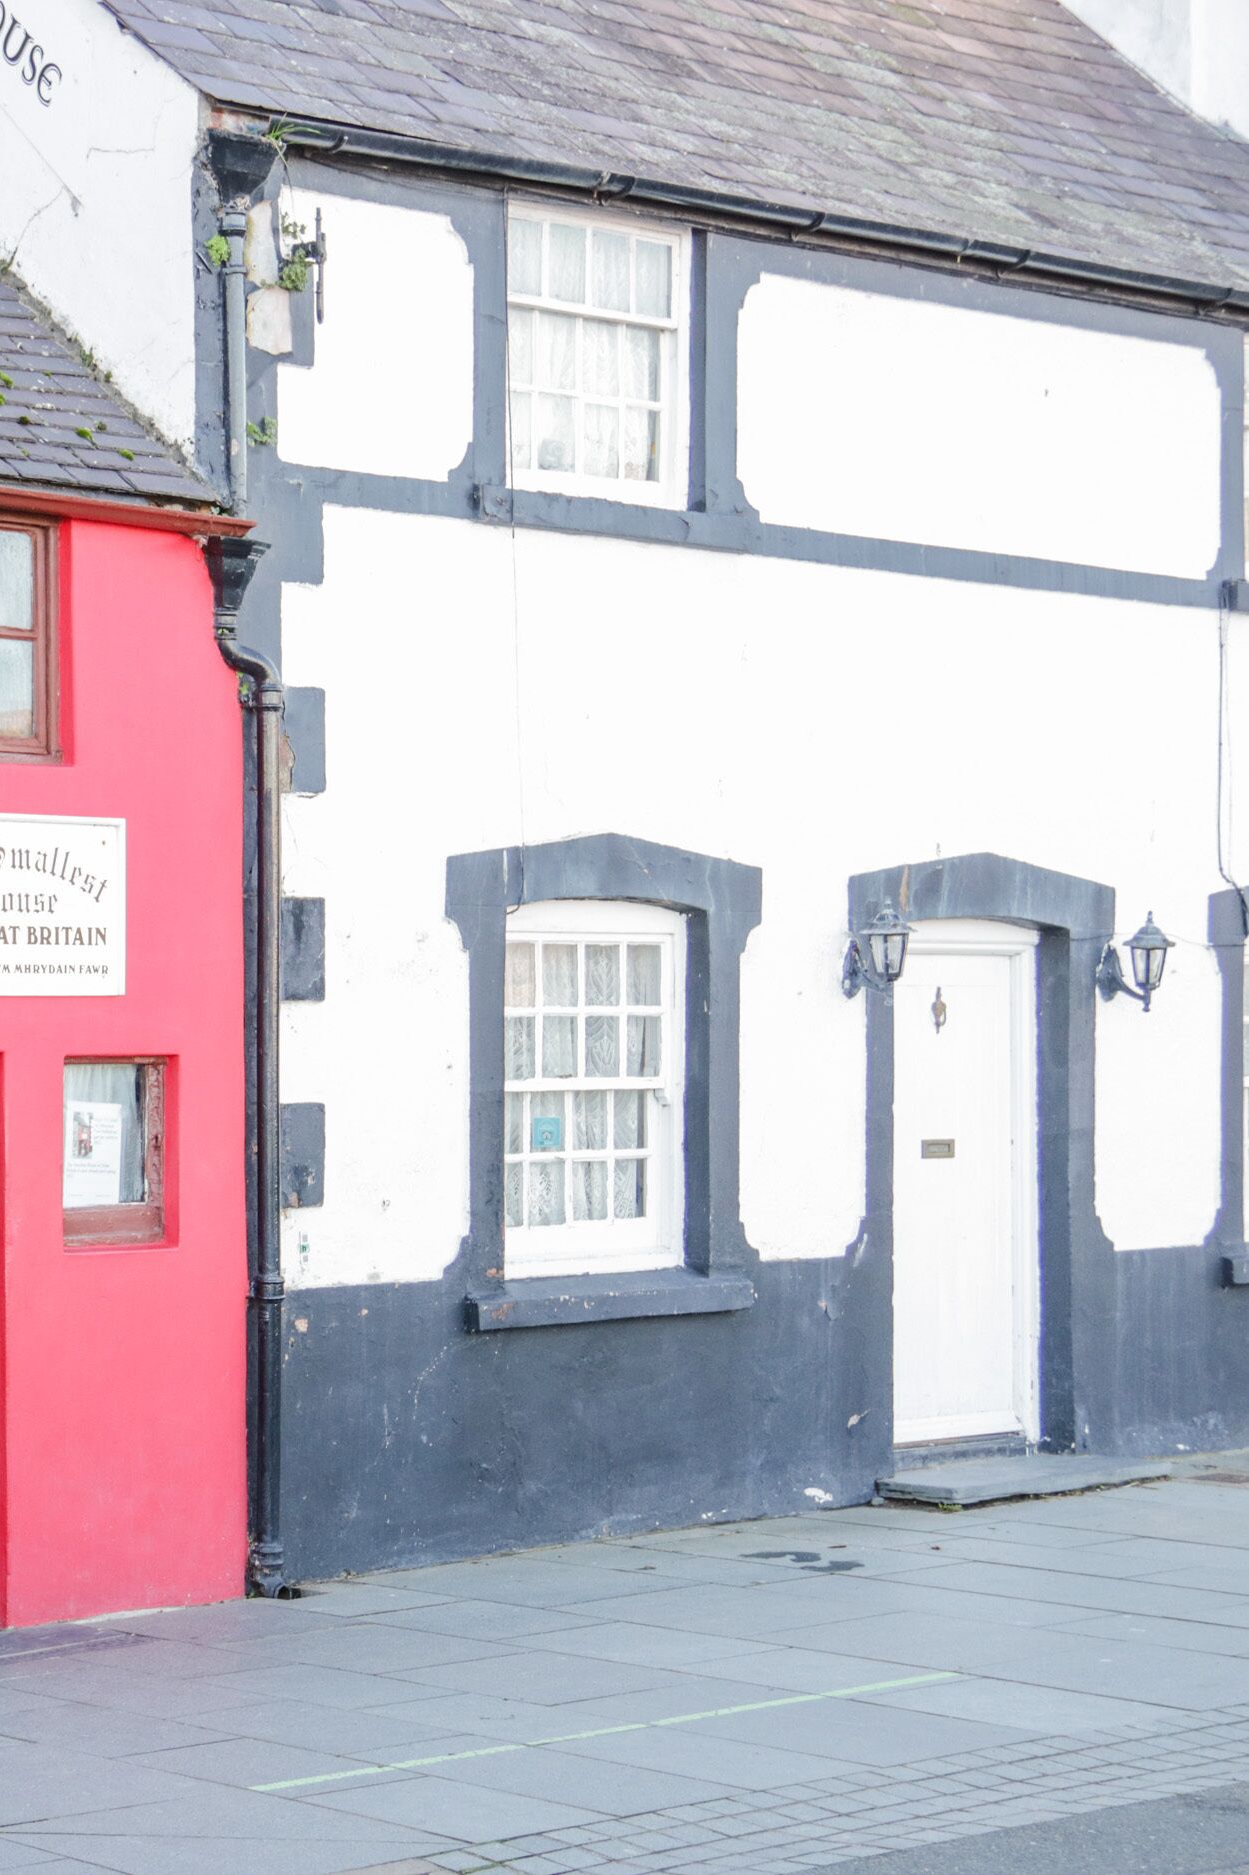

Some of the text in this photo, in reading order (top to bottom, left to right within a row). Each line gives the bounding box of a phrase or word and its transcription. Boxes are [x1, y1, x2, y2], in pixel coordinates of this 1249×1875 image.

[27, 926, 107, 946] BRITAIN
[13, 964, 76, 975] MHRYDAIN
[79, 964, 109, 975] FAWR
